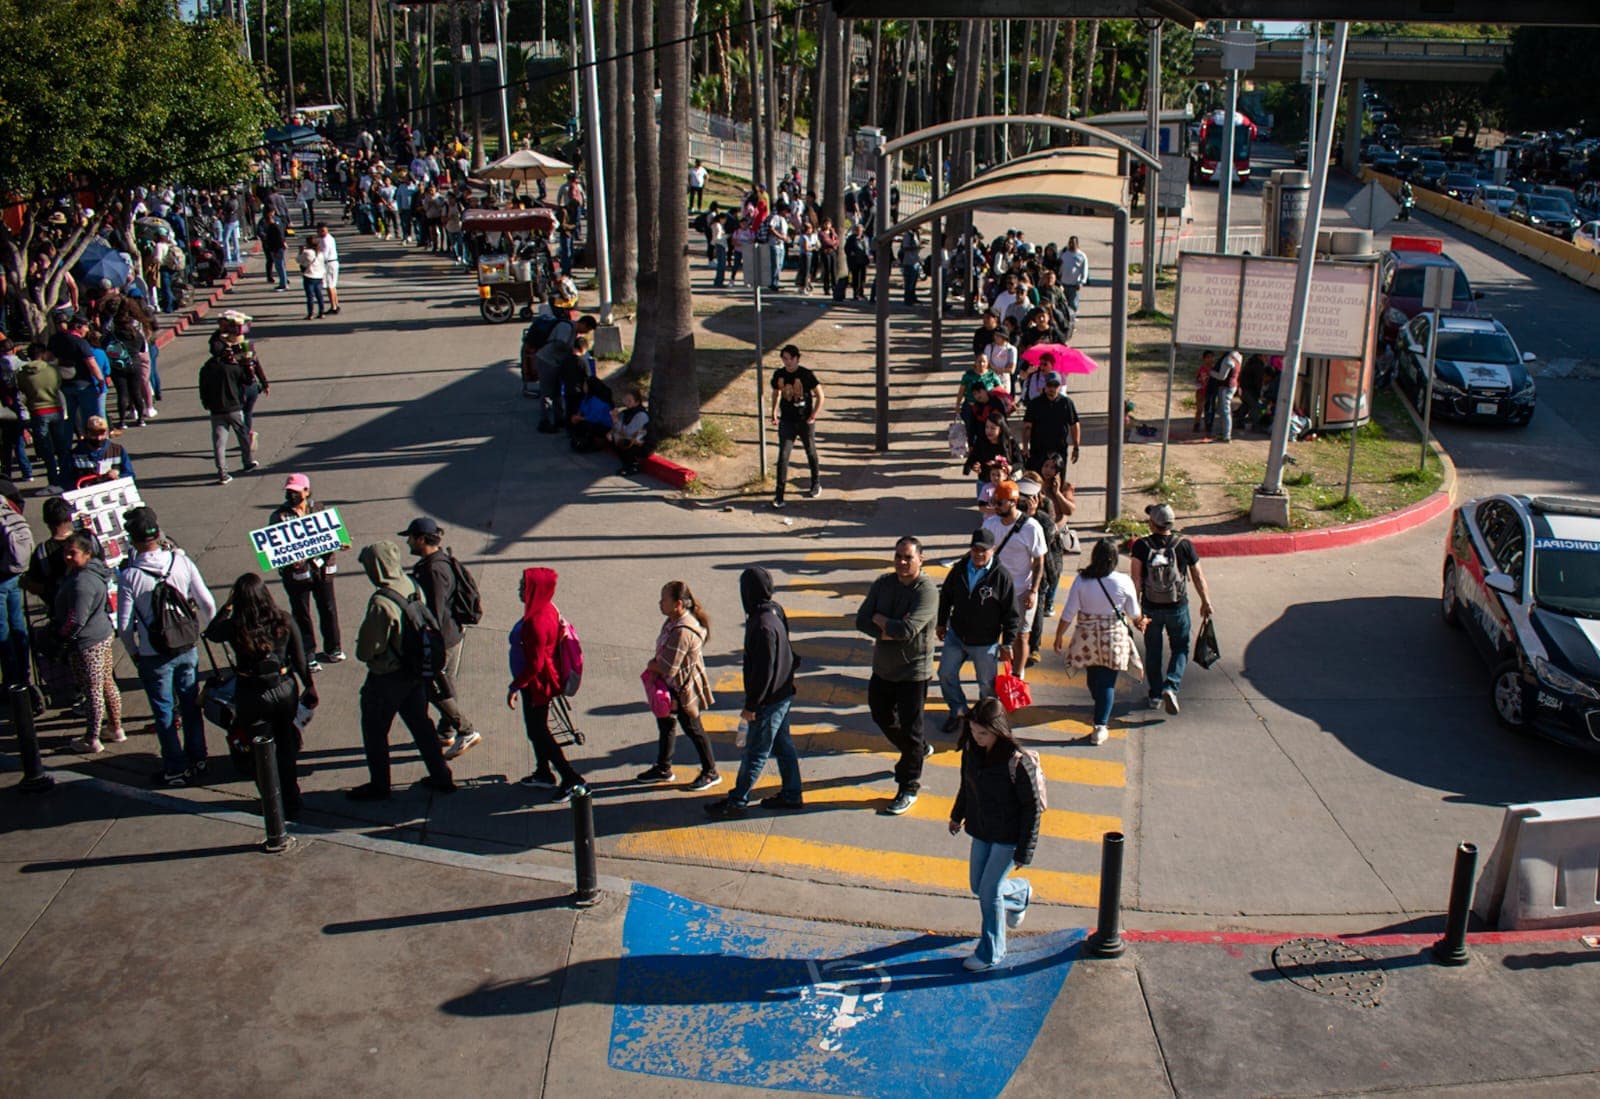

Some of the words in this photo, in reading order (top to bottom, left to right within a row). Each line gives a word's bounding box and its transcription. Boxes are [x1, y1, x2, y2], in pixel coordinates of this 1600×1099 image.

[253, 512, 341, 551] PETCELL
[272, 556, 294, 567] PARA
[306, 541, 341, 557] CELULAR
[274, 534, 332, 557] ACCESORIOS
